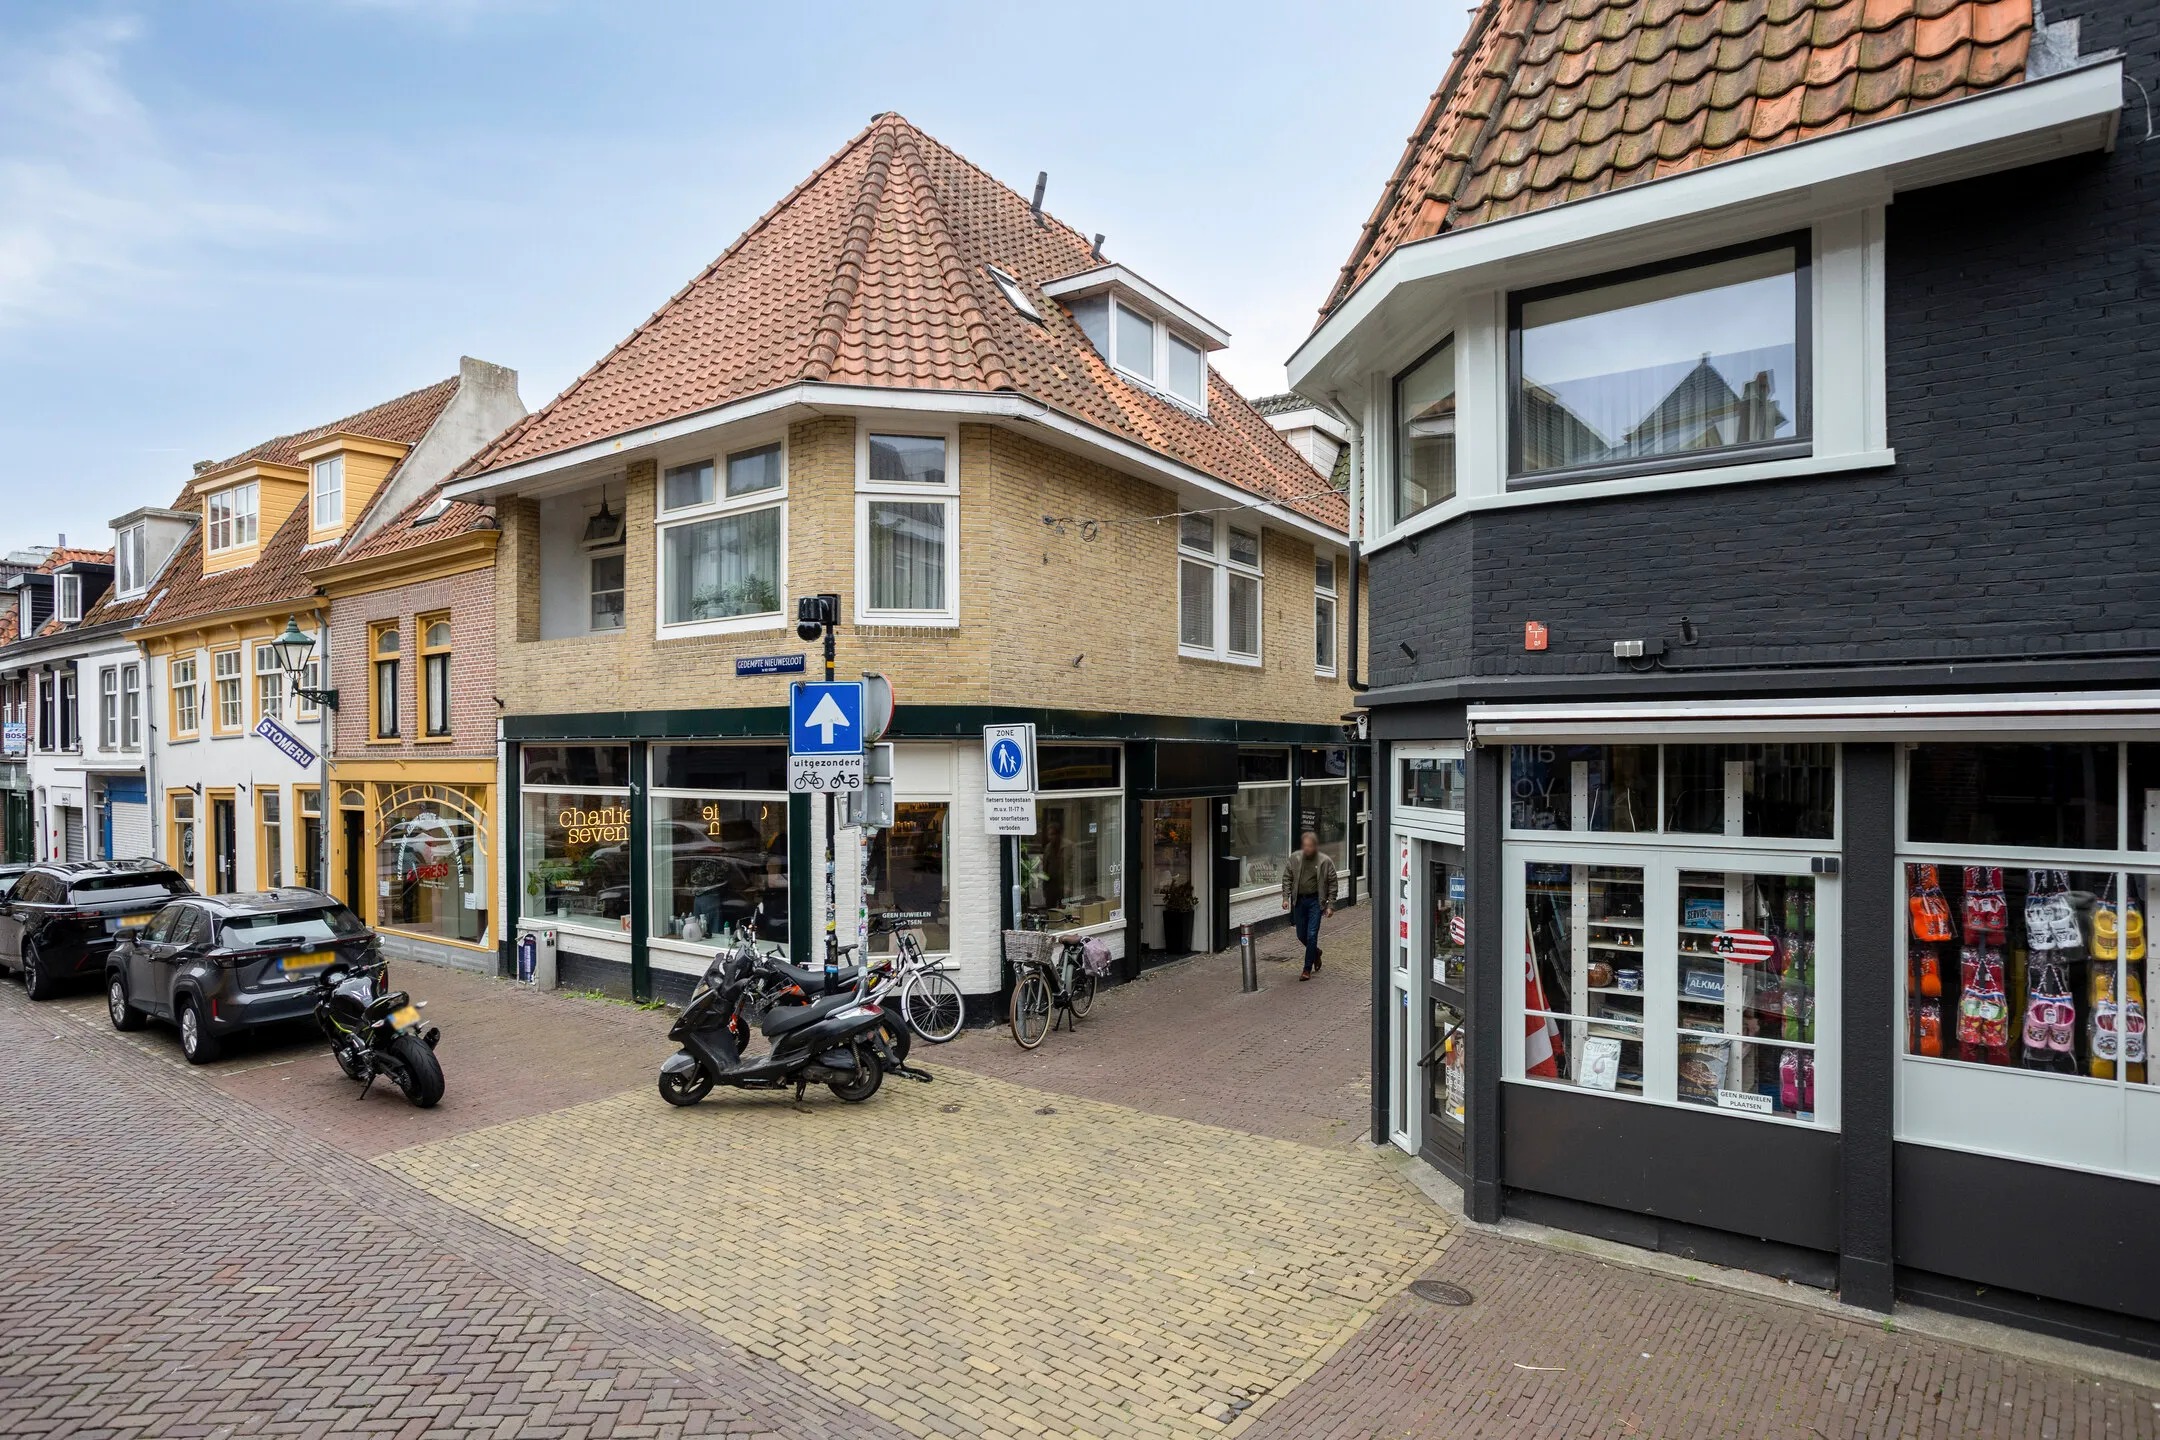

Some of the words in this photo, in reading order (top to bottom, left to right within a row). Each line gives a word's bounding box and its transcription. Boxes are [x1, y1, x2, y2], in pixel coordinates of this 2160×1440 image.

[737, 659, 763, 669] GEDEMPTE
[764, 656, 802, 667] NIEUWESLOOT
[996, 729, 1015, 737] ZONE
[793, 758, 861, 769] uitgezonderd
[559, 806, 631, 829] charlie
[568, 826, 630, 845] seven
[1687, 908, 1708, 920] SERVICE
[1720, 1091, 1738, 1099] GEEN
[1738, 1093, 1772, 1104] RIJWIELEN
[1729, 1100, 1762, 1110] PLAATSEN
